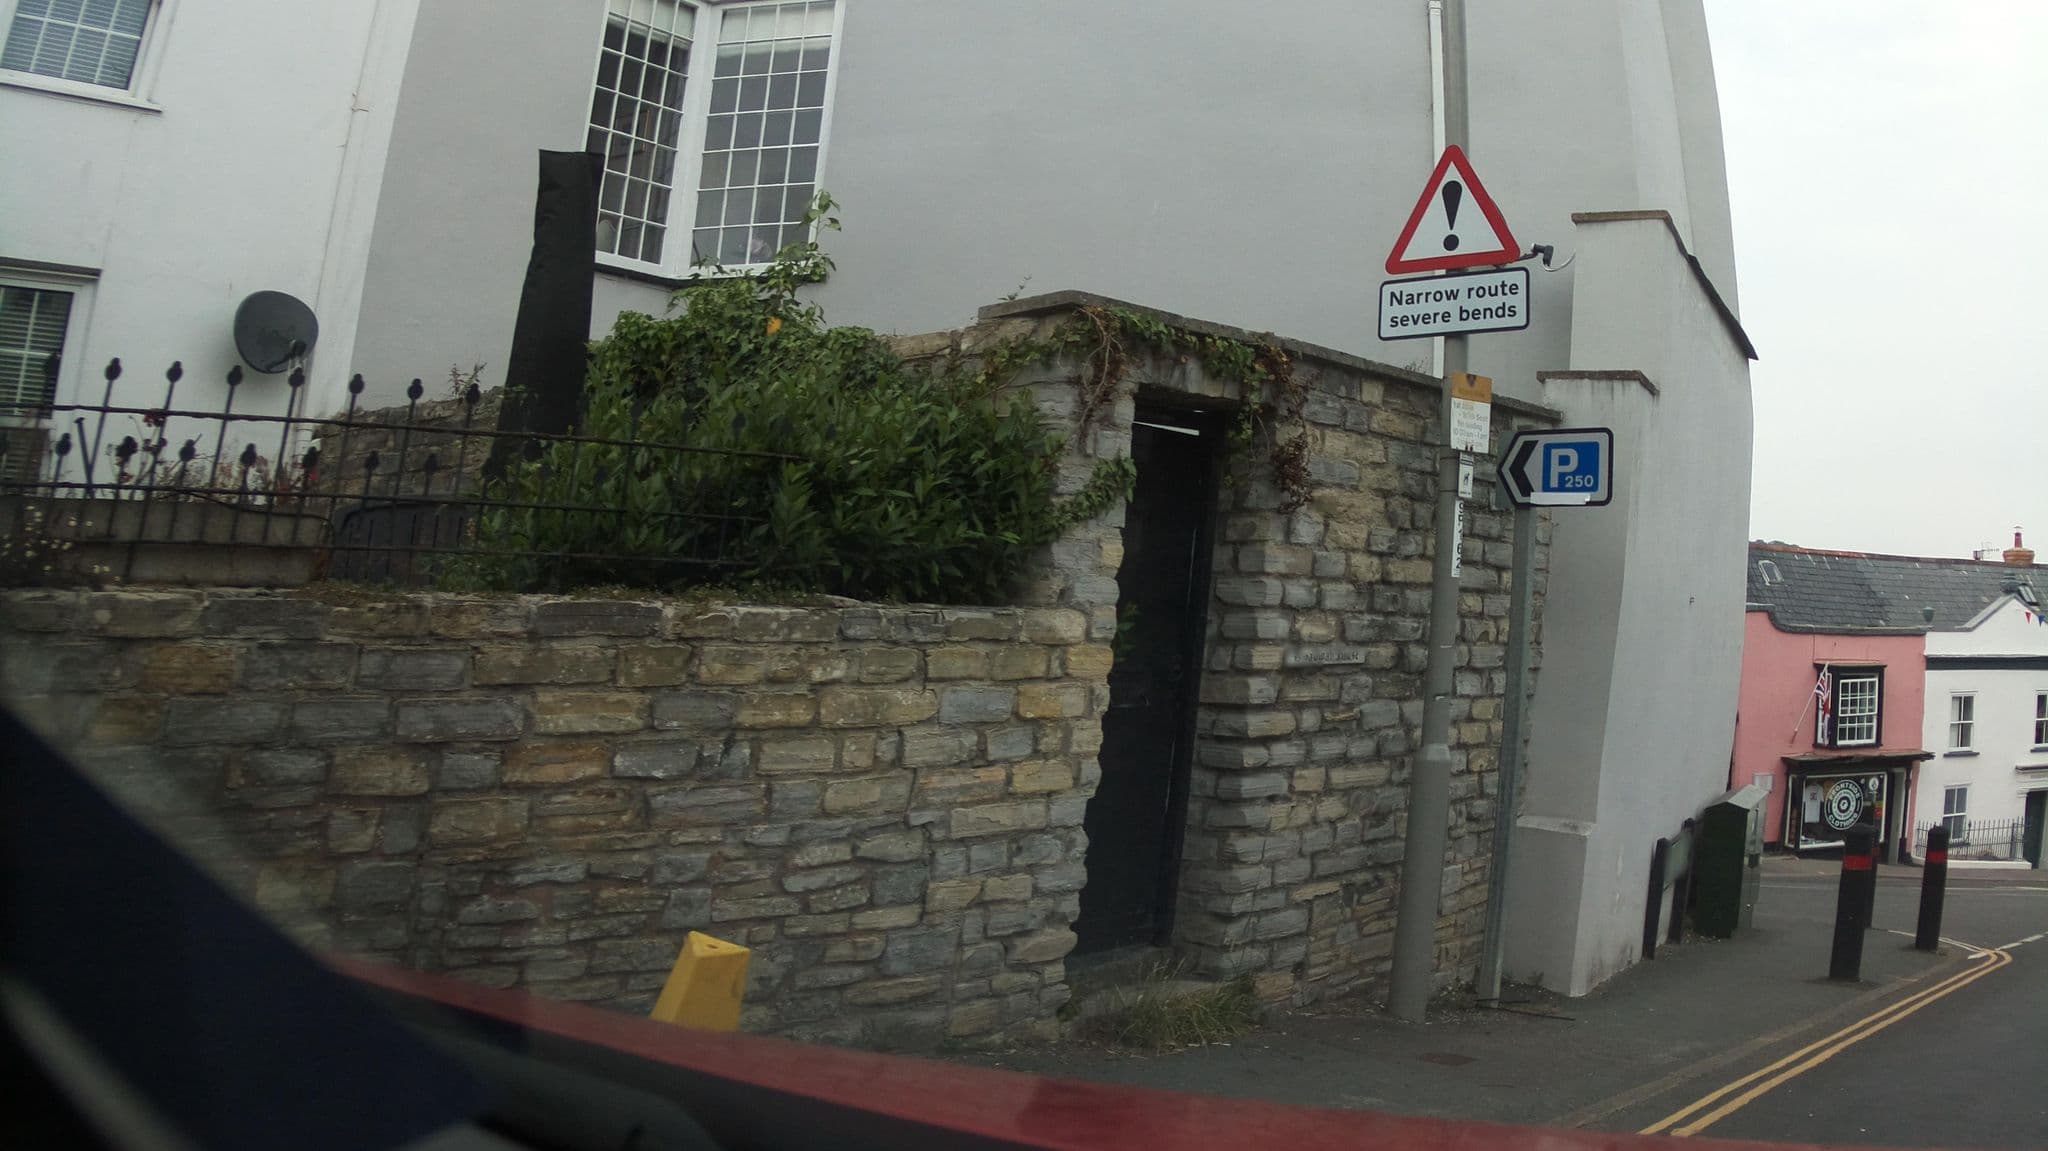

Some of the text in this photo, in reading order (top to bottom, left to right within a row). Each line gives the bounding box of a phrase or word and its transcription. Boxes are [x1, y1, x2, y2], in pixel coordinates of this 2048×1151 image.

[1389, 280, 1519, 307] Narrow route
[1389, 302, 1517, 328] severe bends
[1549, 447, 1594, 489] P 250
[1828, 782, 1861, 800] FRONTSIDE
[1828, 812, 1859, 828] CLOTHING
